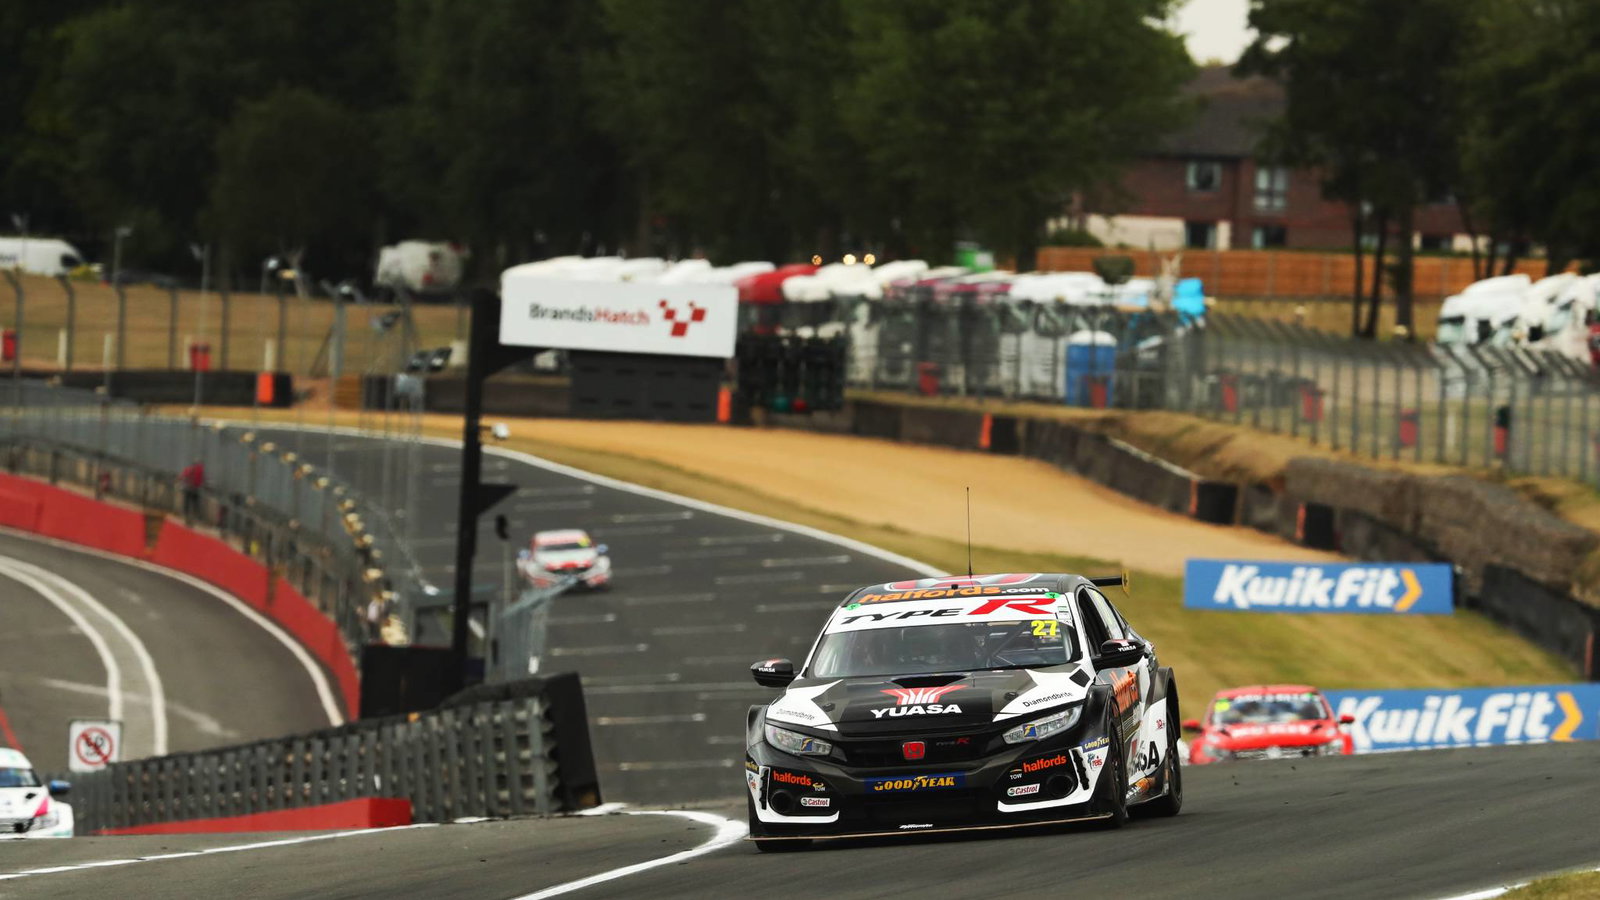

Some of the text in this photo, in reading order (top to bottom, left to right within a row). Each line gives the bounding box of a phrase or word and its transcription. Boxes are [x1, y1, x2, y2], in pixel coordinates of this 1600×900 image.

[859, 586, 1050, 603] halfords.com
[841, 598, 1057, 625] TYPE R
[1031, 620, 1058, 637] 27
[1022, 691, 1074, 708] Diamondbrite
[775, 708, 815, 721] Diamondbrite
[870, 704, 963, 719] YUASA
[1023, 755, 1067, 773] halfords
[773, 770, 812, 786] halfords
[874, 776, 955, 791] GOODYEAR
[1015, 785, 1038, 795] Castrol
[807, 798, 828, 806] Castrol
